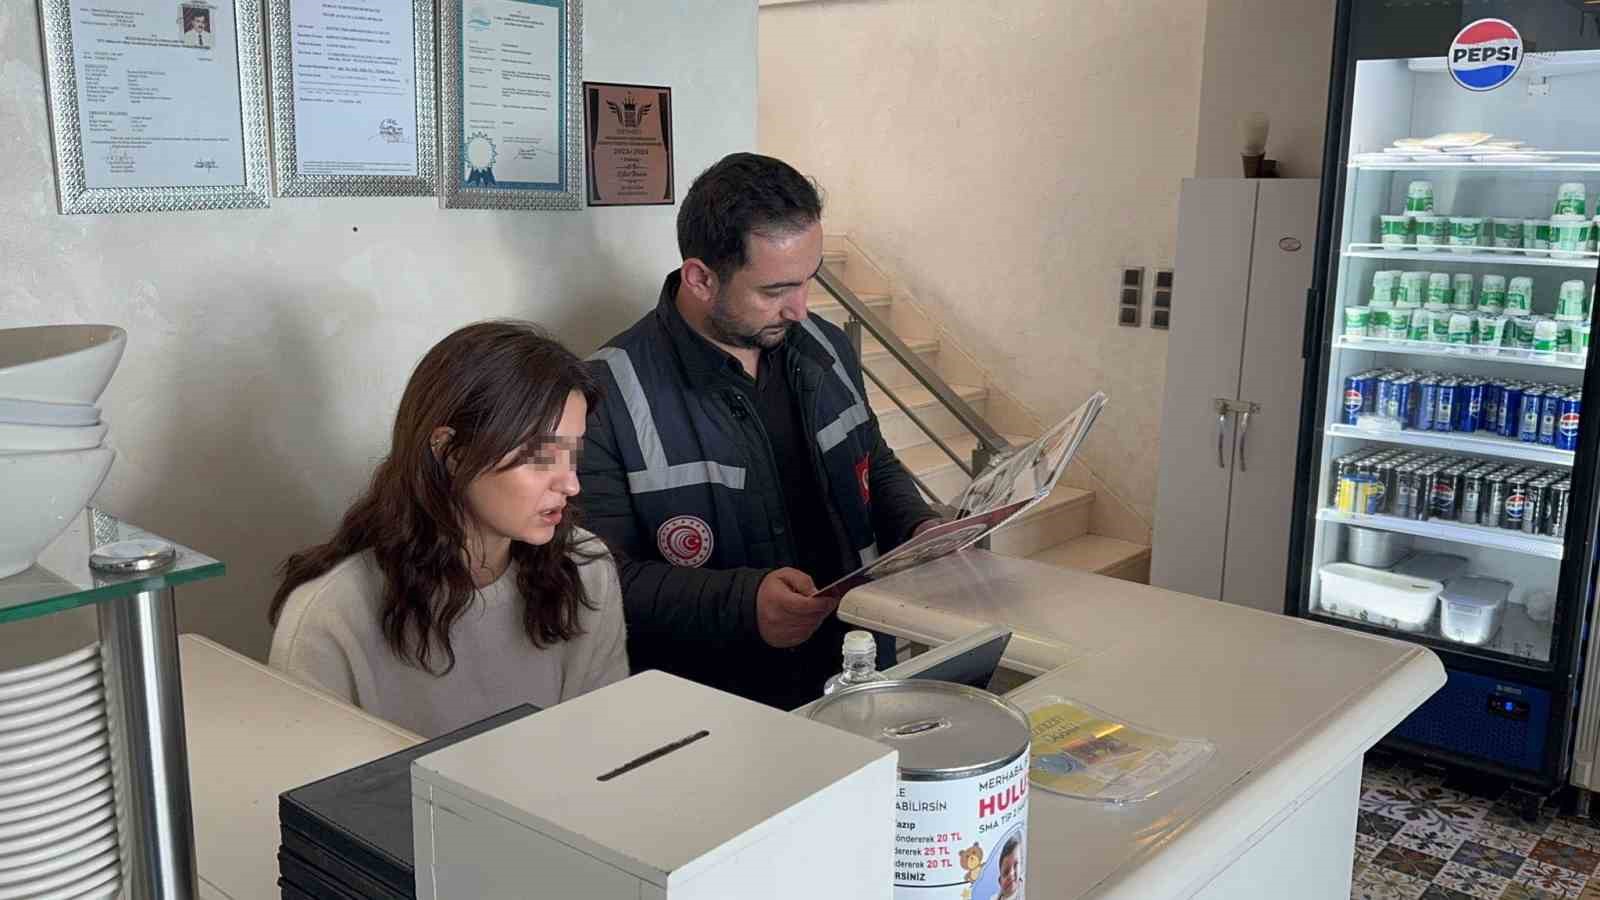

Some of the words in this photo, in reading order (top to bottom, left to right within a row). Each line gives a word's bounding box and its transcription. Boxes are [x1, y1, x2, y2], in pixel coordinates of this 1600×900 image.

[1453, 46, 1519, 63] PEPSI
[896, 788, 906, 798] E
[896, 820, 916, 831] azıp
[978, 819, 999, 834] SMA
[895, 833, 934, 843] öndererek
[936, 833, 948, 843] 20
[950, 832, 962, 841] TL
[924, 847, 936, 856] 25
[938, 846, 950, 855] TL
[927, 859, 938, 869] 20
[940, 858, 952, 867] TL
